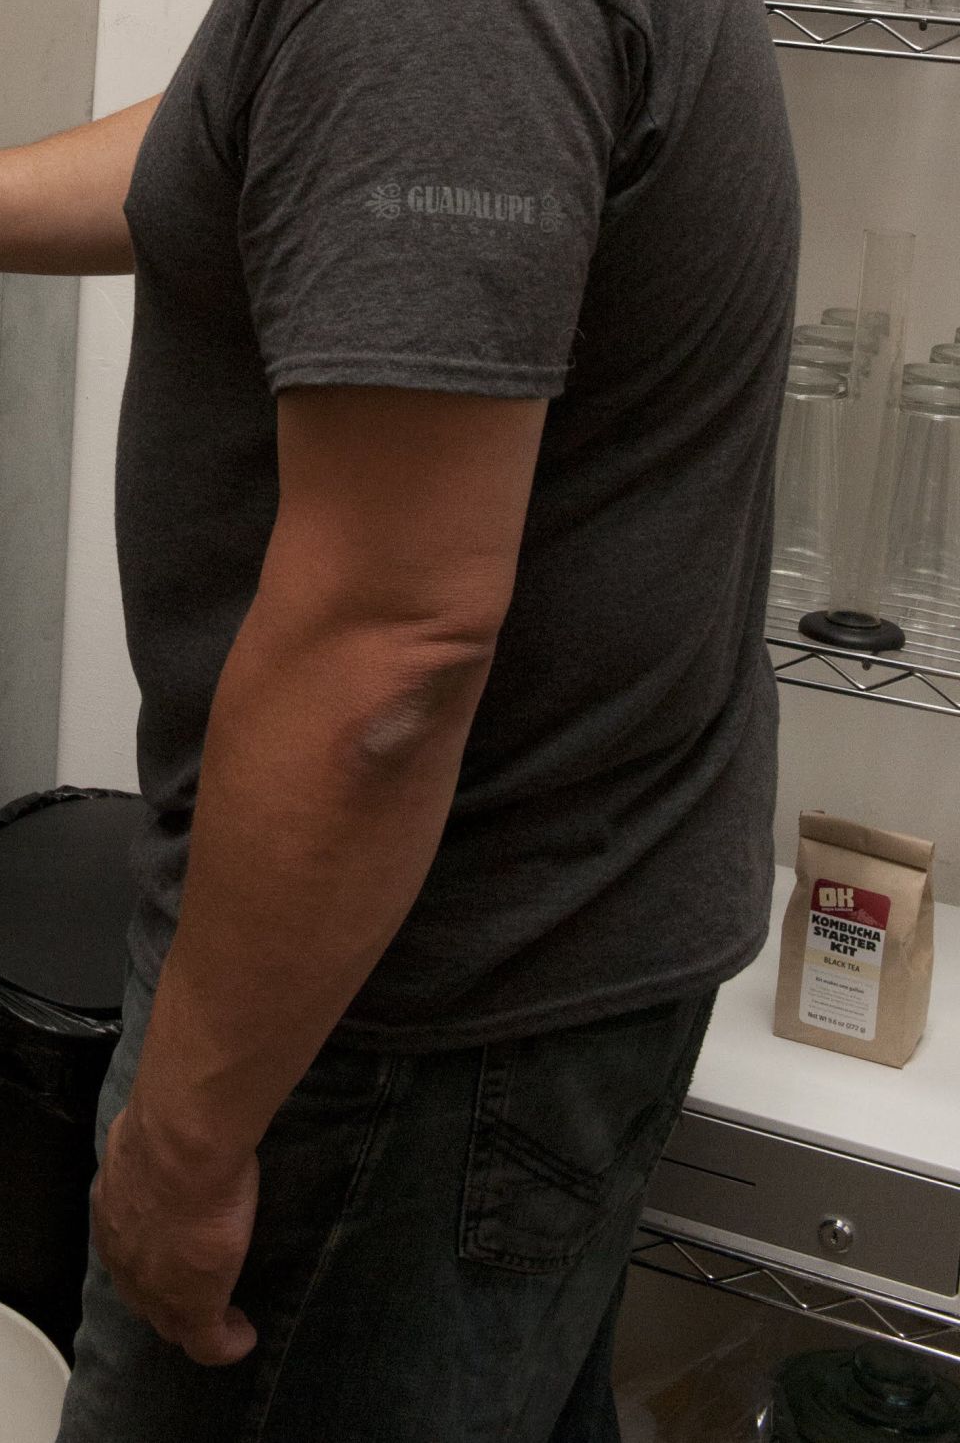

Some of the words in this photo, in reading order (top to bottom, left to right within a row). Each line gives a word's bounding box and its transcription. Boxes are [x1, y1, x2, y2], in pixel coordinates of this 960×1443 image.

[407, 186, 536, 225] GUADALUPE
[819, 887, 854, 907] OK
[812, 914, 881, 943] KOMBUCHA
[814, 926, 876, 952] STARTER
[830, 941, 858, 957] KIT
[824, 956, 846, 969] BLACK
[848, 963, 860, 972] TEA
